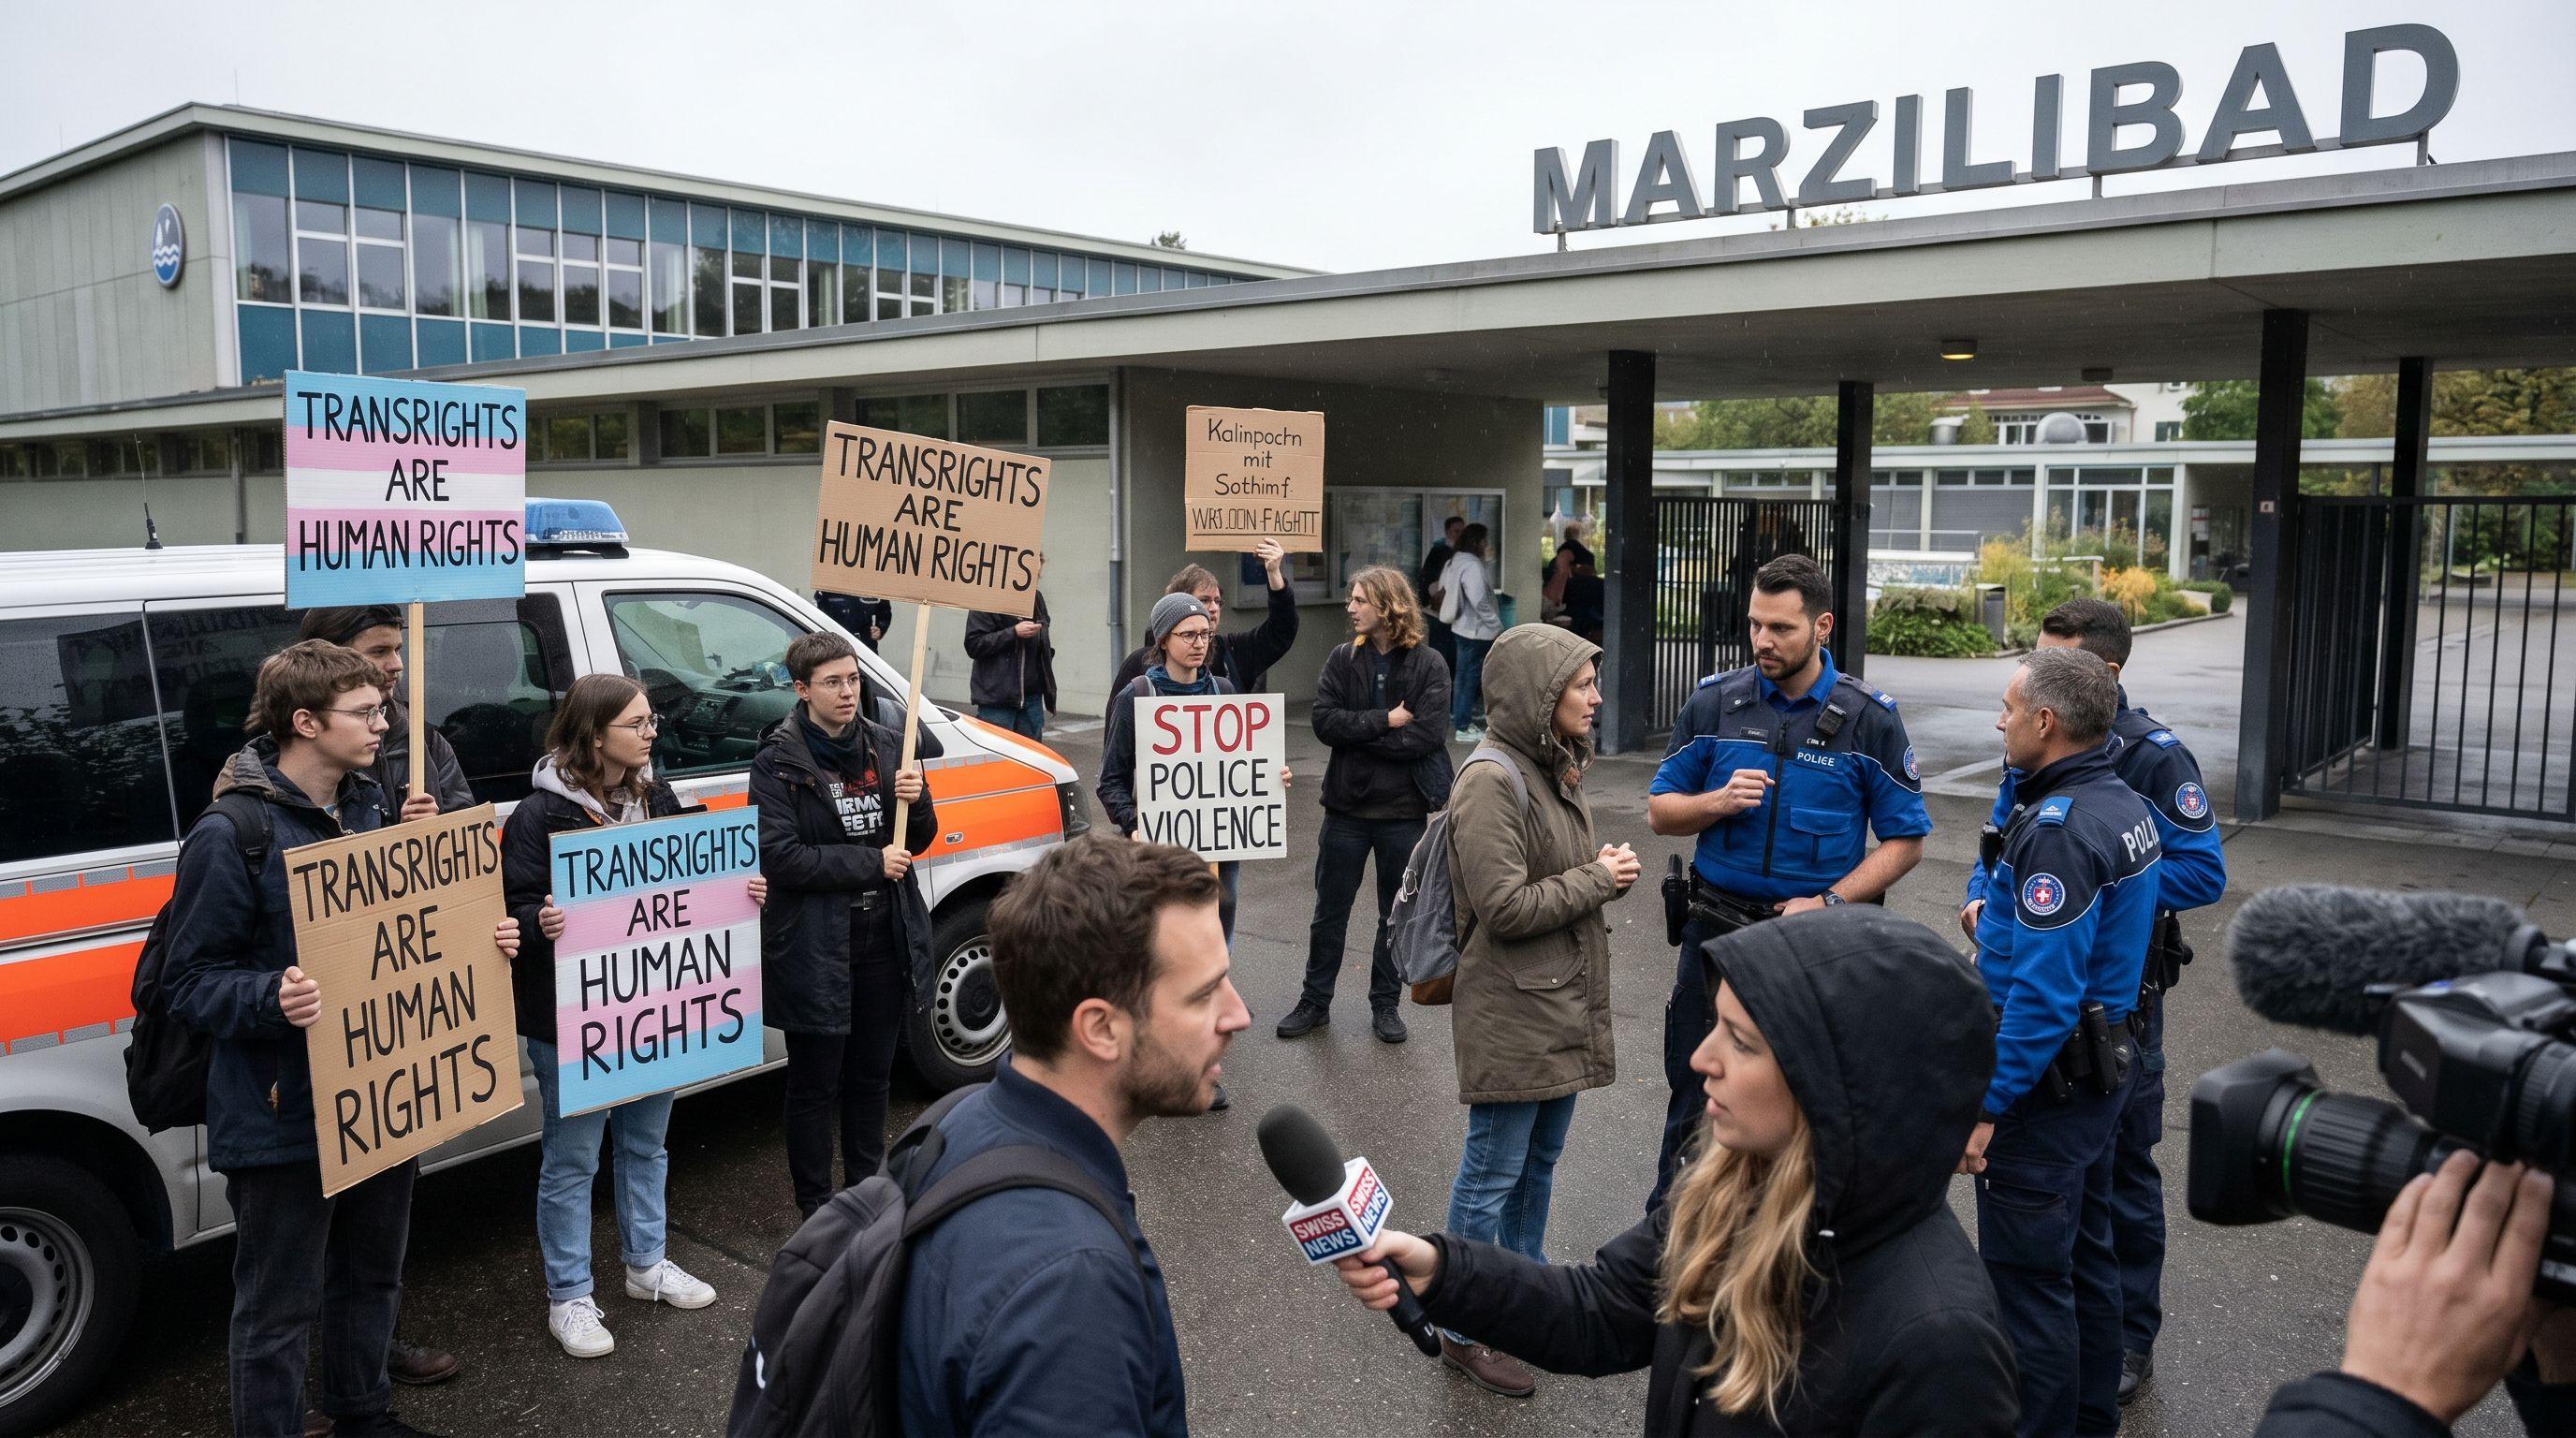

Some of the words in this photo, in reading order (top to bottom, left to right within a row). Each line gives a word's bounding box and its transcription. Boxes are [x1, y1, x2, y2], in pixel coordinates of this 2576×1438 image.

[1533, 22, 2460, 234] MARZILIBAD
[298, 391, 518, 450] TRANSRIGHTS
[385, 458, 449, 502] ARE
[834, 433, 1042, 507] TRANSRIGHTS
[1243, 450, 1273, 469] mit
[894, 492, 964, 533] ARE
[300, 520, 410, 572] HUMAN
[420, 520, 519, 567] RIGHTS
[819, 519, 923, 577] HUMAN
[930, 535, 1034, 592] RIGHTS
[1151, 701, 1271, 756] STOP
[1149, 757, 1269, 802] POLICE
[1141, 803, 1282, 852] VIOLENCE
[292, 820, 498, 922] TRANSRIGHTS
[558, 823, 756, 898] TRANSRIGHTS
[626, 888, 692, 937] ARE
[371, 904, 443, 981] ARE
[579, 929, 731, 1012] HUMAN
[342, 964, 476, 1069] HUMAN
[581, 988, 744, 1081] RIGHTS
[334, 1034, 497, 1166] RIGHTS
[1349, 1170, 1377, 1216] SWISS
[1358, 1185, 1388, 1232] NEWS
[1294, 1211, 1346, 1240] SWISS
[1303, 1228, 1358, 1258] NEWS
